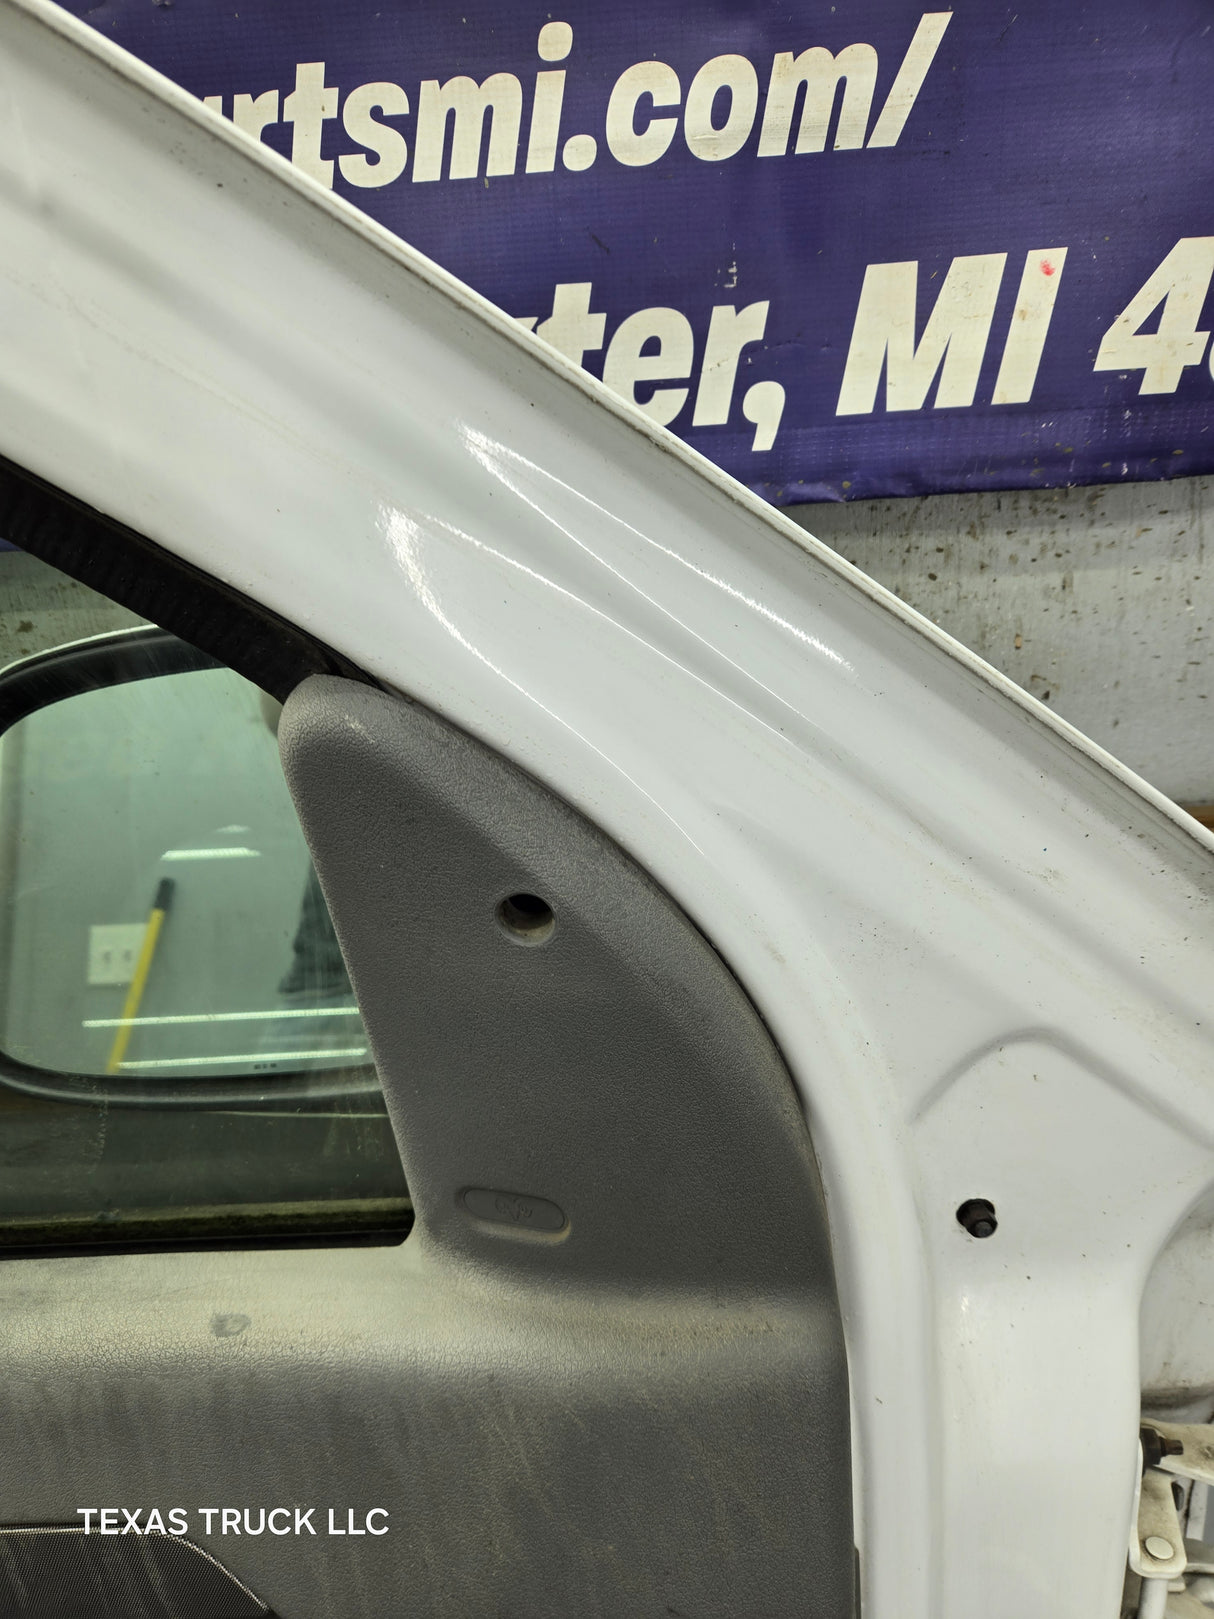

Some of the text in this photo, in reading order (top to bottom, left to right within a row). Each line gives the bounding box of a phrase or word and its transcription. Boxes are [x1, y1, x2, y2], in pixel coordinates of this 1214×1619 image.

[201, 12, 953, 189] rtsmi.com/
[513, 236, 1214, 451] ter, MI 4
